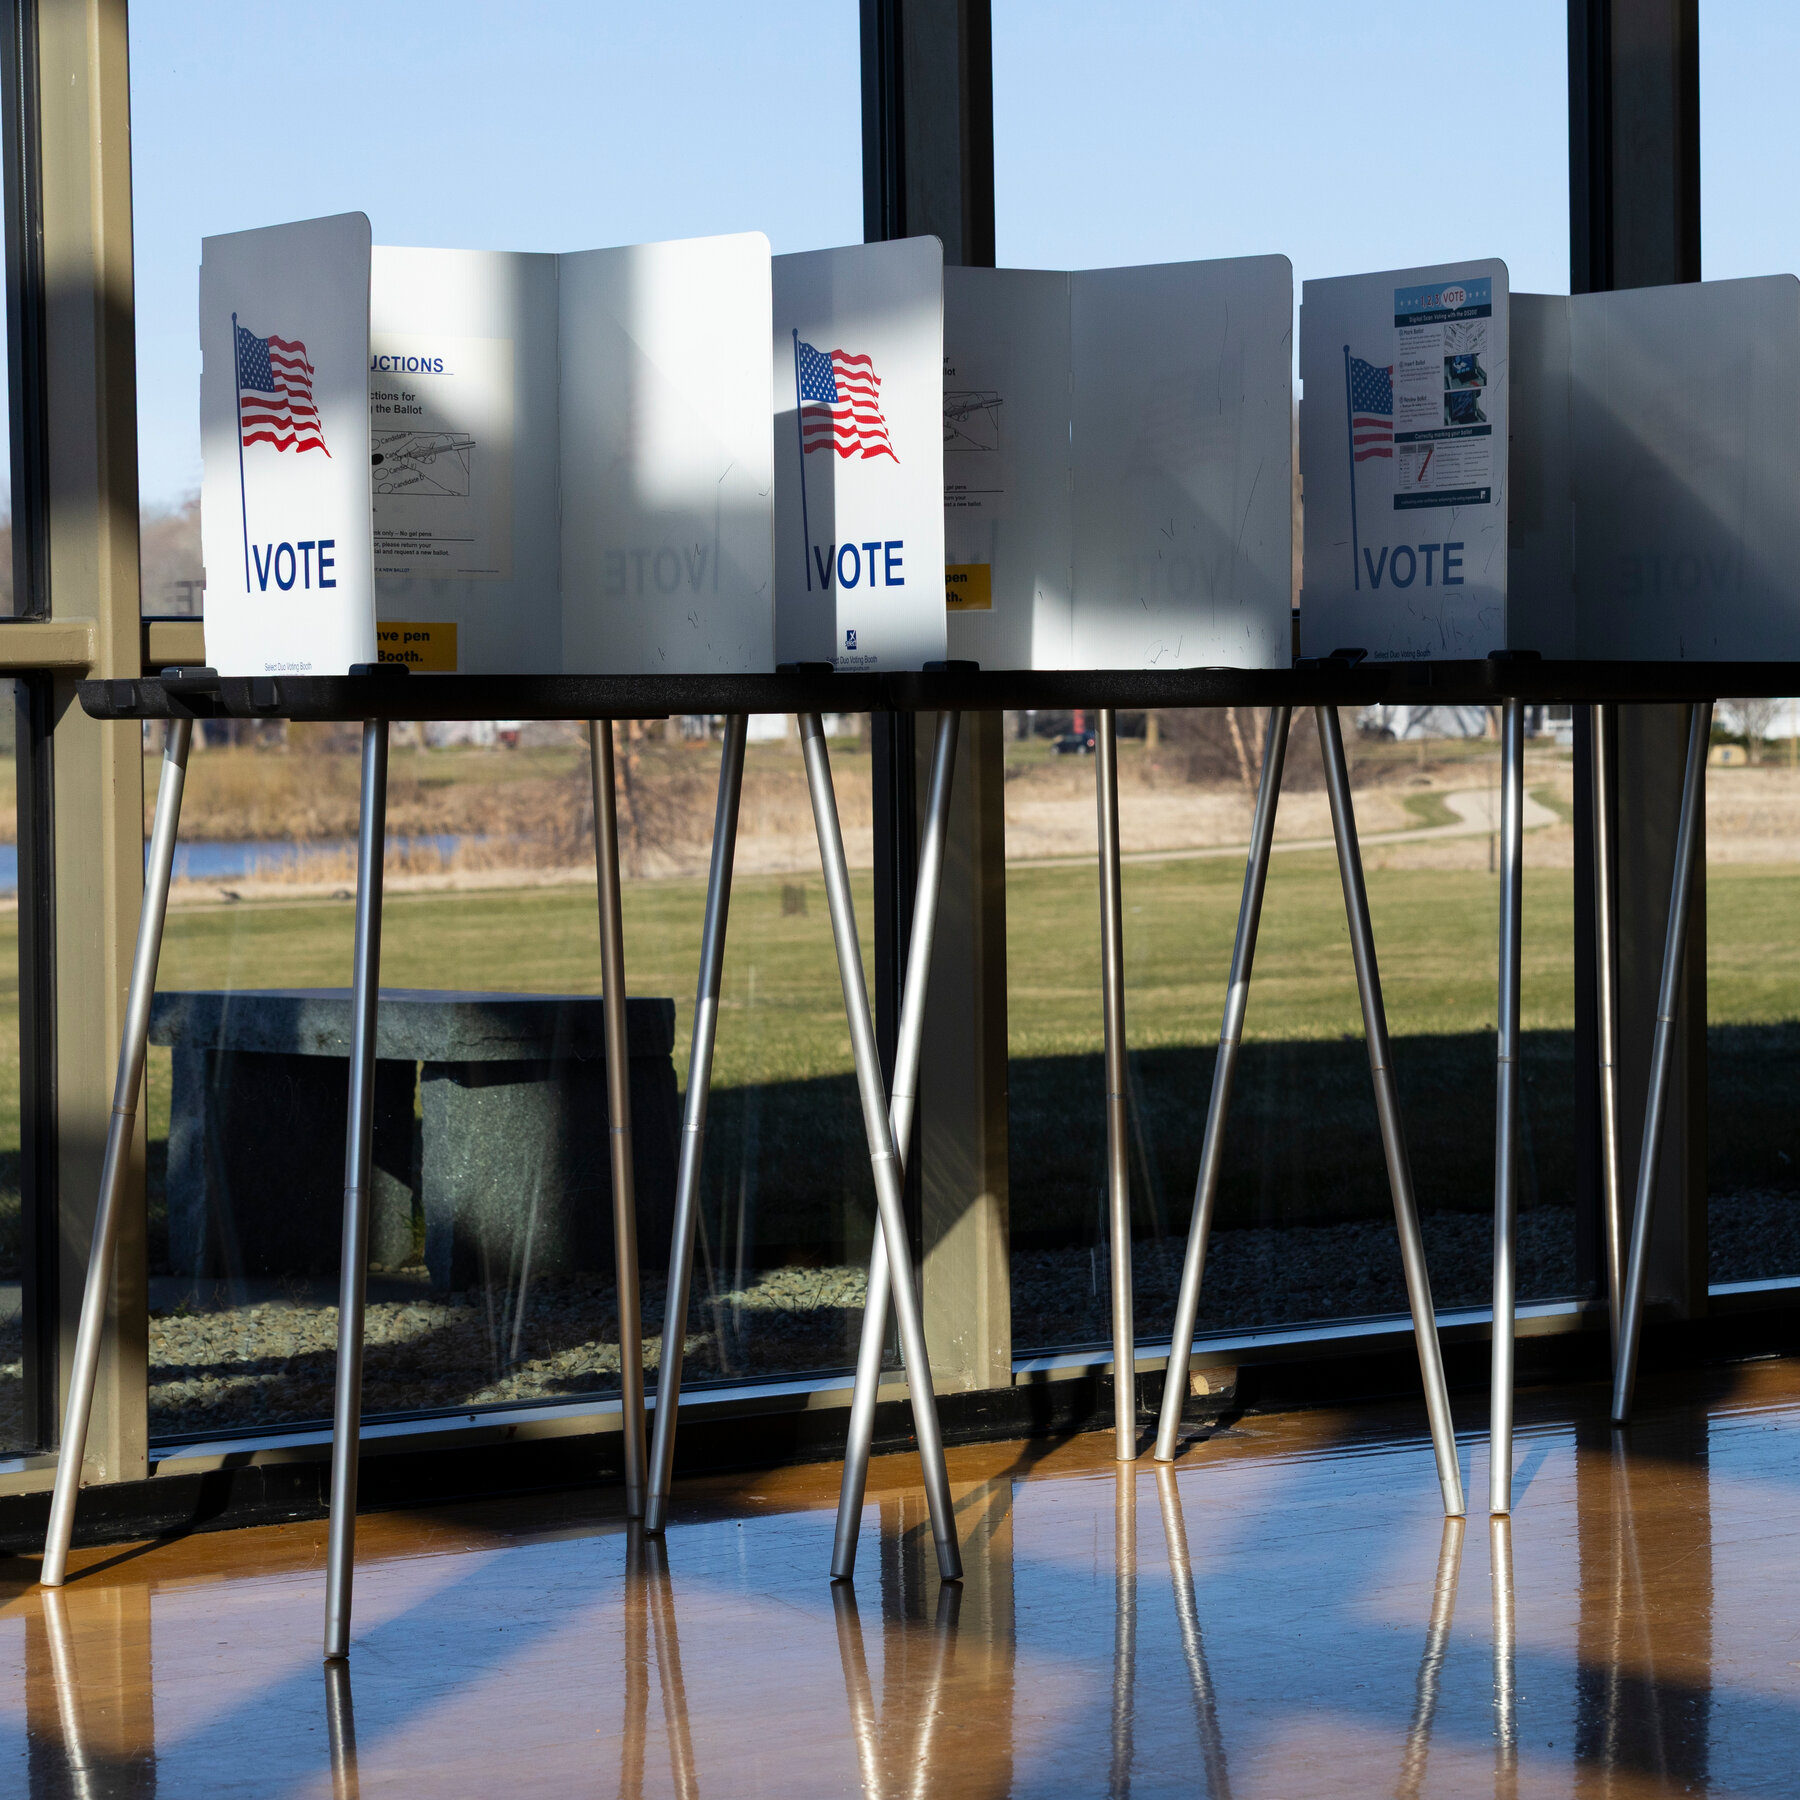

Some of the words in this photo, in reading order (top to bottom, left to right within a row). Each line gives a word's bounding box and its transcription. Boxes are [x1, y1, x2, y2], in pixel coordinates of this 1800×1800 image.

[1443, 290, 1464, 303] VOTE
[402, 392, 416, 402] for
[376, 404, 392, 414] the
[394, 404, 422, 415] Ballot
[381, 433, 407, 444] Candidate
[394, 477, 419, 488] Candidate
[252, 538, 337, 592] VOTE
[814, 540, 905, 590] VOTE
[1363, 542, 1464, 589] VOTE
[946, 574, 968, 586] pen
[404, 632, 430, 644] pen
[378, 650, 423, 662] Booth.
[1374, 650, 1388, 658] Select
[1390, 650, 1400, 658] Duo
[1400, 649, 1415, 658] Voting
[1417, 649, 1431, 657] Booth
[840, 656, 849, 664] Duo
[850, 655, 864, 665] Voting
[864, 655, 878, 664] Booth
[265, 662, 277, 672] Select
[278, 662, 286, 671] Duo
[287, 663, 299, 672] Voting
[300, 662, 312, 670] Booth
